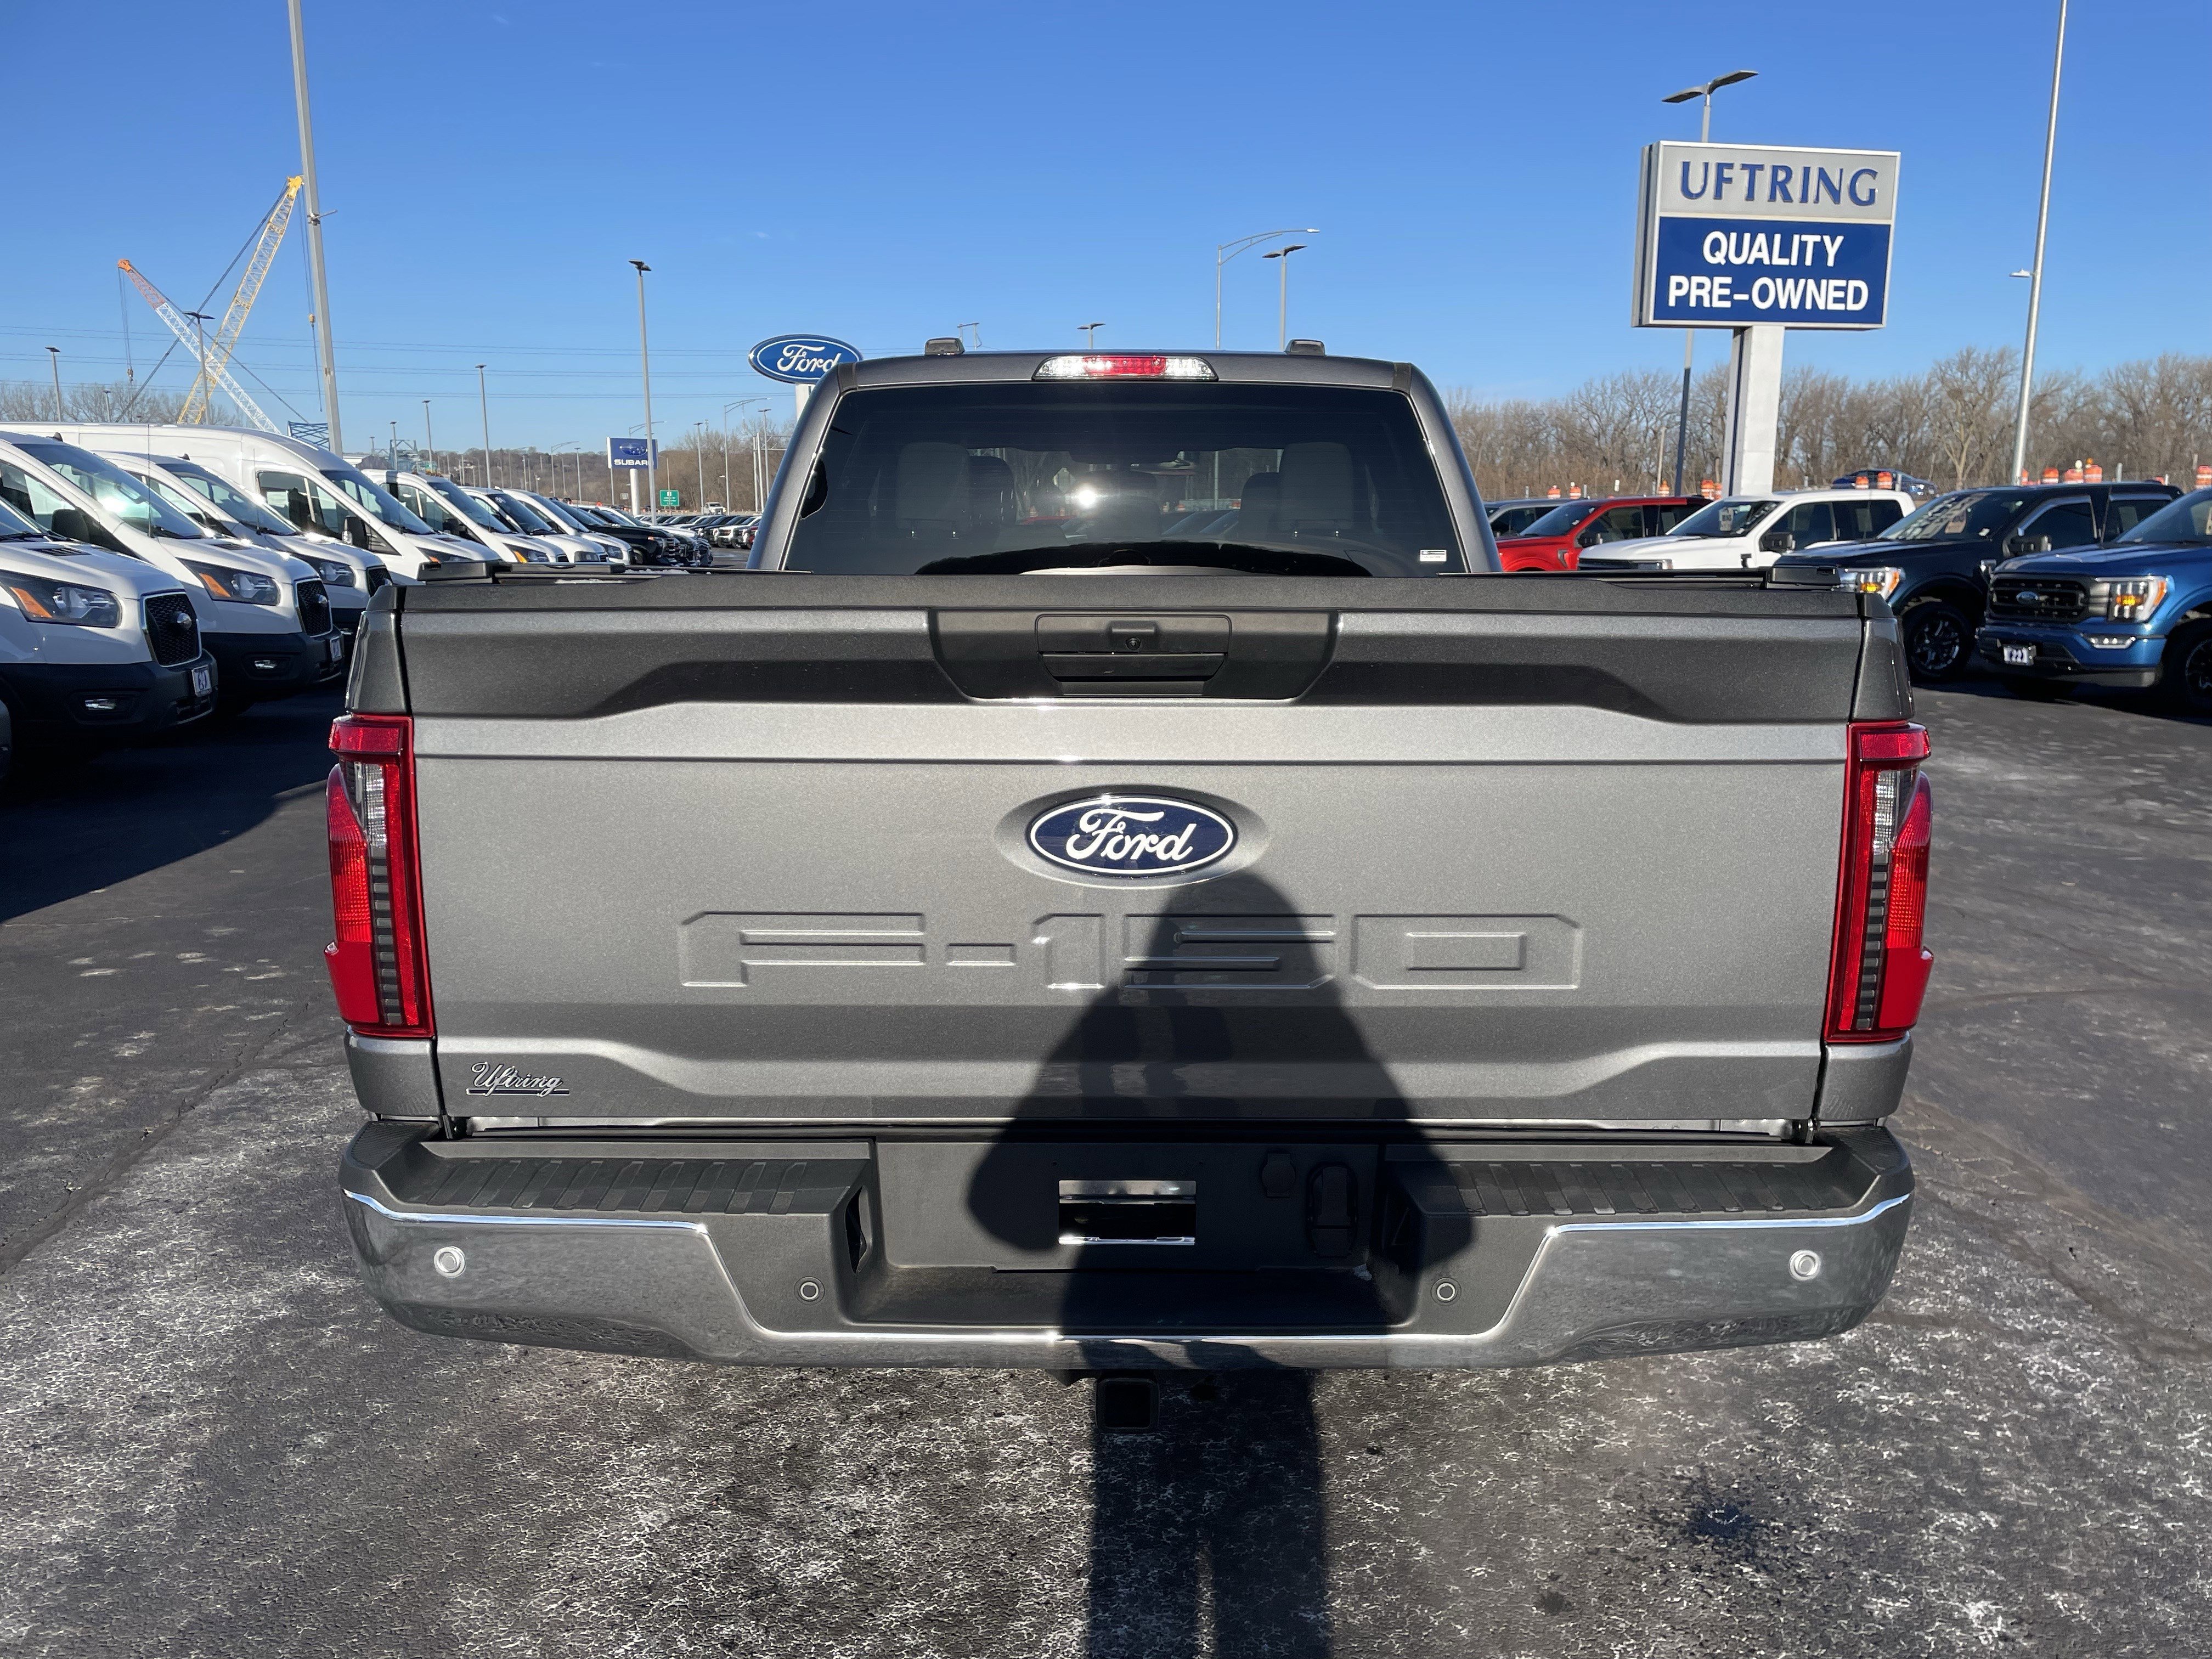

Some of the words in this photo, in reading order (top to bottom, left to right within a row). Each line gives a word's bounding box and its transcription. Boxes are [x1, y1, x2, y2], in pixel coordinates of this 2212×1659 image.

[1680, 161, 1879, 206] UFTRING
[1702, 230, 1844, 267] QUALITY
[1668, 275, 1869, 311] PRE-OWNED
[777, 344, 842, 372] Ford
[1065, 809, 1197, 861] Ford
[678, 911, 1583, 991] F-150
[471, 1062, 563, 1097] Uftring
